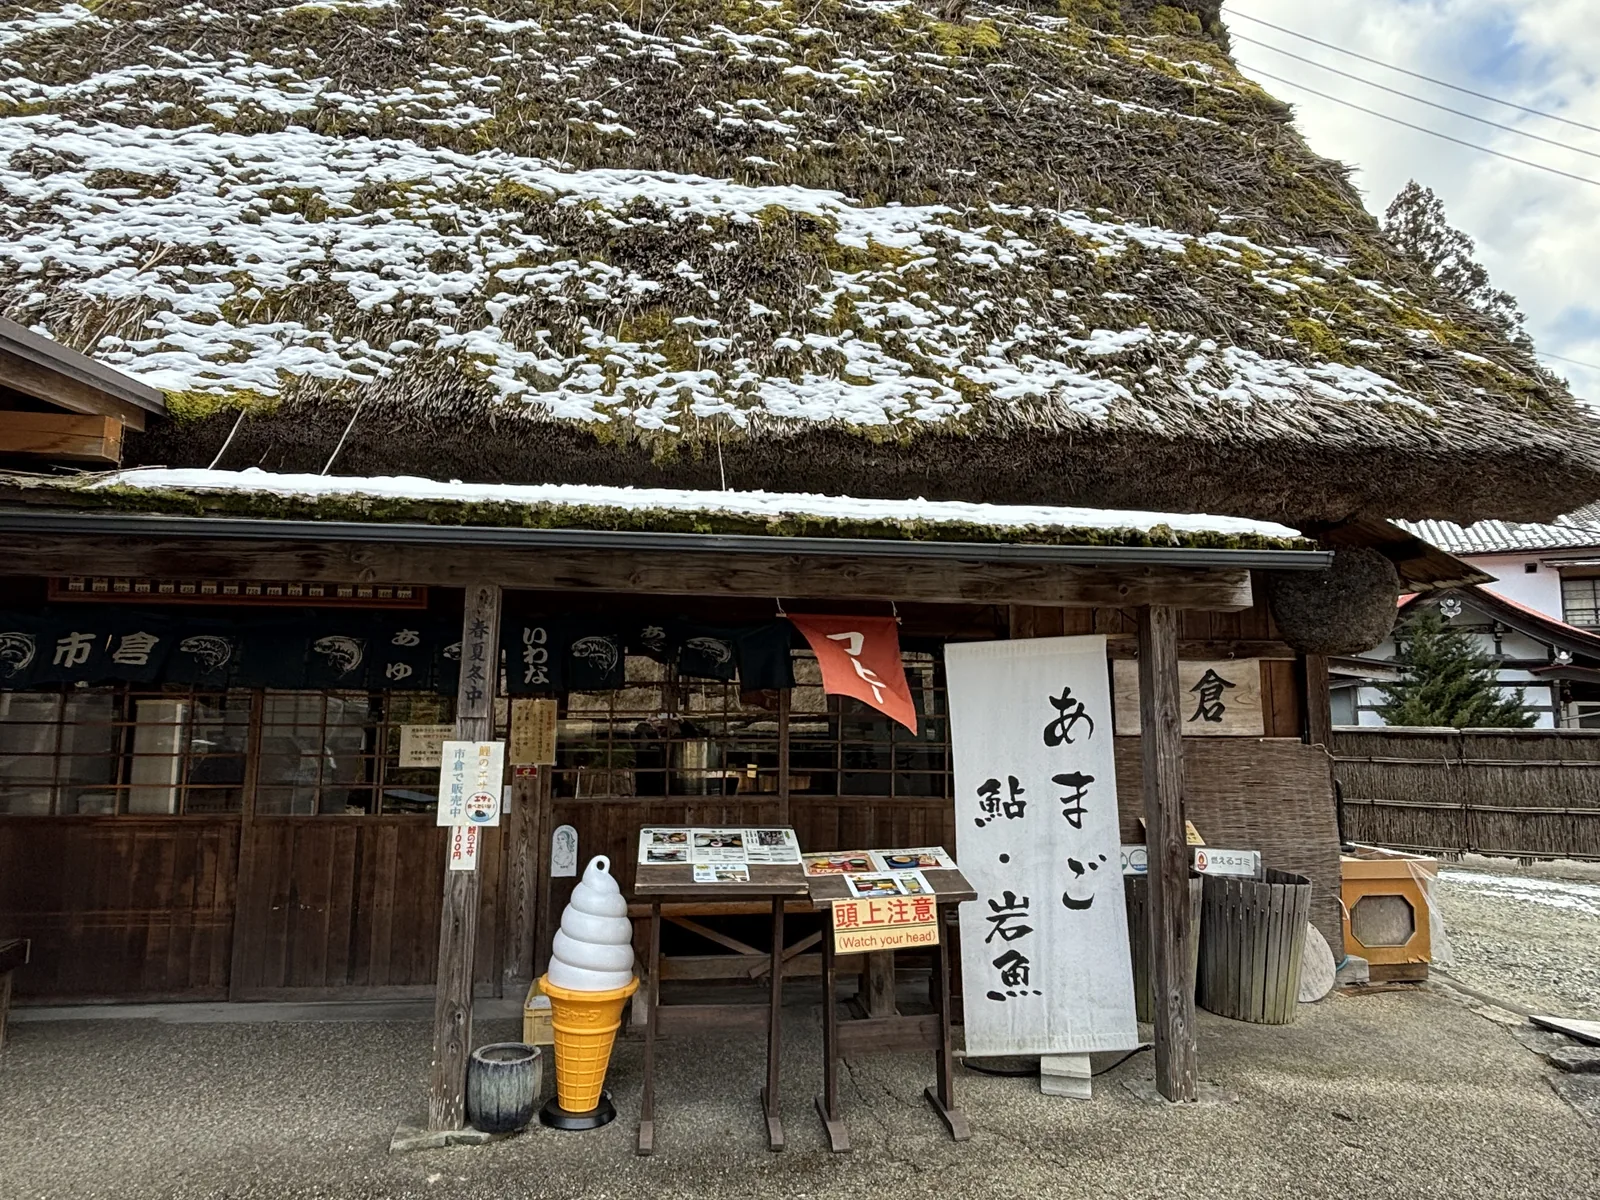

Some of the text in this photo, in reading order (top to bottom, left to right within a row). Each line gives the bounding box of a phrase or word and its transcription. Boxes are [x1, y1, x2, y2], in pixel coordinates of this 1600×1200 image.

[52, 631, 160, 668] 市倉
[385, 628, 421, 681] あゆ
[465, 618, 489, 709] 春夏冬中
[522, 626, 550, 685] いわな
[449, 748, 467, 820] 市倉で販売中
[476, 745, 491, 790] 鯉のエサ
[1043, 686, 1108, 910] あまご
[465, 825, 477, 857] 鯉のエサ
[1210, 856, 1251, 867] 燃えるゴミ
[834, 896, 935, 929] 頭上注意
[974, 775, 1043, 1003] 鮎・岩魚
[838, 929, 937, 951] (Watch your head)
